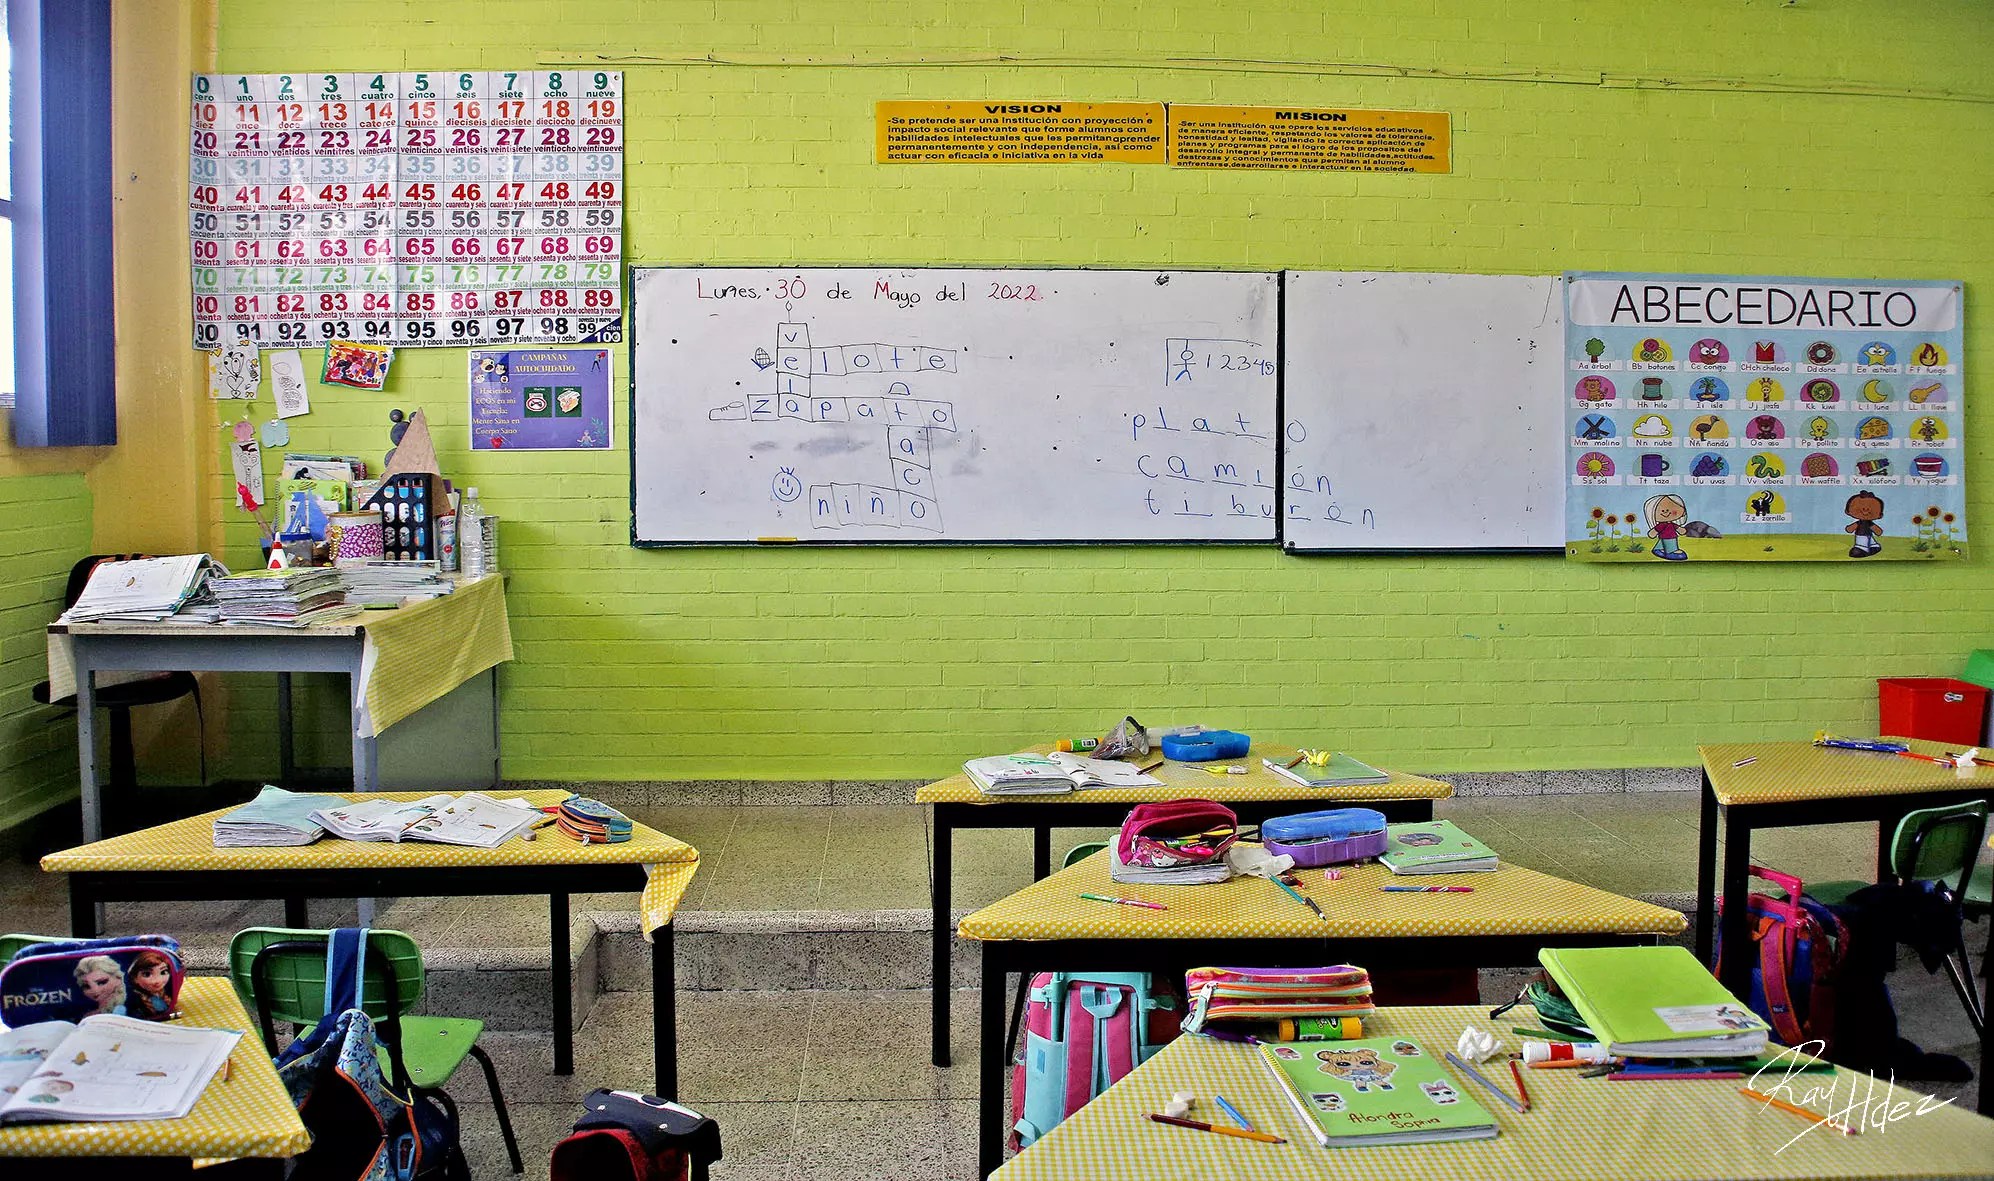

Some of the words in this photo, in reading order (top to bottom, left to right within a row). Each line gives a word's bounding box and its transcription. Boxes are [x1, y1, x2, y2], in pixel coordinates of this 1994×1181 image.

[196, 76, 210, 94] 0
[238, 76, 248, 94] 1
[280, 76, 293, 94] 2
[324, 75, 338, 92] 3
[370, 75, 385, 92] 4
[415, 74, 429, 92] 5
[460, 74, 474, 91] 6
[504, 73, 518, 90] 7
[548, 72, 562, 90] 8
[594, 72, 608, 90] 9
[321, 92, 342, 100] tres
[361, 92, 394, 100] cuatro
[456, 90, 476, 98] seis
[498, 90, 524, 98] siete
[544, 90, 568, 98] ocho
[194, 104, 217, 122] 10
[236, 104, 259, 122] 11
[277, 104, 303, 121] 12
[318, 103, 348, 120] 13
[365, 102, 392, 120] 14
[408, 102, 436, 119] 15
[454, 102, 480, 118] 16
[498, 101, 524, 118] 17
[542, 100, 570, 118] 18
[588, 100, 614, 117] 19
[984, 105, 1062, 114] VISION
[1276, 112, 1346, 121] MISION
[236, 122, 260, 130] once
[446, 118, 488, 126] dieciseis
[536, 118, 576, 126] dieciocho
[909, 117, 956, 125] pretende
[1084, 117, 1144, 125] proyección
[542, 128, 570, 145] 28
[888, 126, 930, 134] impacto
[1022, 126, 1040, 134] que
[321, 131, 350, 148] 23
[534, 145, 576, 153] veintiocho
[406, 156, 436, 174] 35
[452, 184, 481, 200] 46
[541, 210, 570, 227] 58
[406, 238, 435, 256] 65
[275, 268, 304, 284] 72
[494, 290, 523, 308] 87
[775, 278, 807, 299] 30
[826, 282, 852, 300] de
[874, 280, 921, 305] Mayo
[936, 283, 966, 302] del
[320, 294, 348, 311] 83
[1610, 284, 1917, 327] ABECEDARIO
[406, 322, 436, 338] 95
[578, 323, 596, 334] 99
[594, 332, 620, 342] 100
[522, 352, 568, 361] CAMPAÑAS
[1591, 362, 1612, 370] árbol
[1704, 364, 1727, 372] conejo
[1707, 439, 1729, 448] ñandú
[1817, 440, 1839, 448] pollito
[3, 988, 73, 1010] FROZEN
[1349, 1111, 1414, 1124] Alondra
